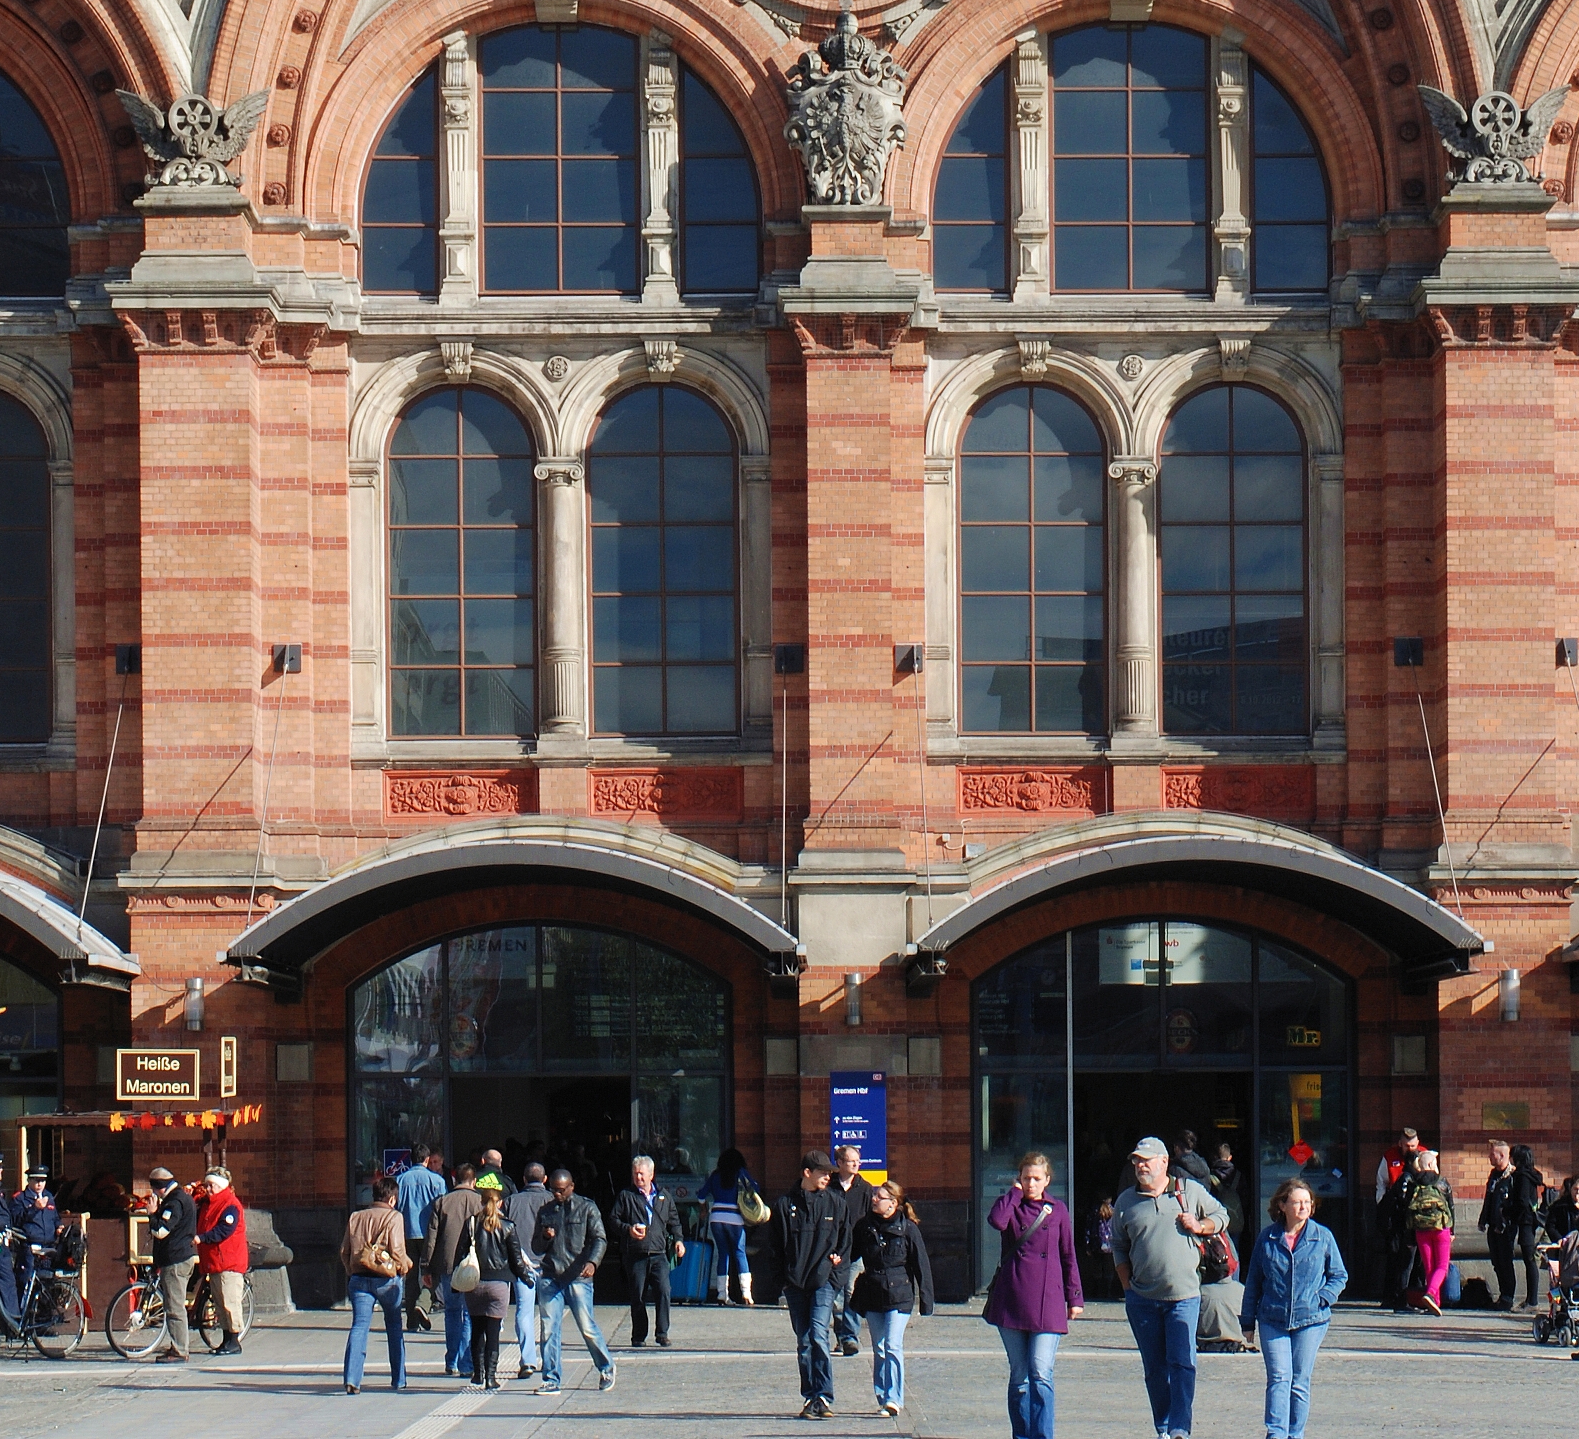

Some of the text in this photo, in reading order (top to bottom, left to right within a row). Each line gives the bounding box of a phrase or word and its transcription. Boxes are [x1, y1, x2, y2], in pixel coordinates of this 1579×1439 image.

[137, 1057, 180, 1071] Heiße
[126, 1079, 190, 1094] Maronen
[476, 1181, 503, 1191] adidas
